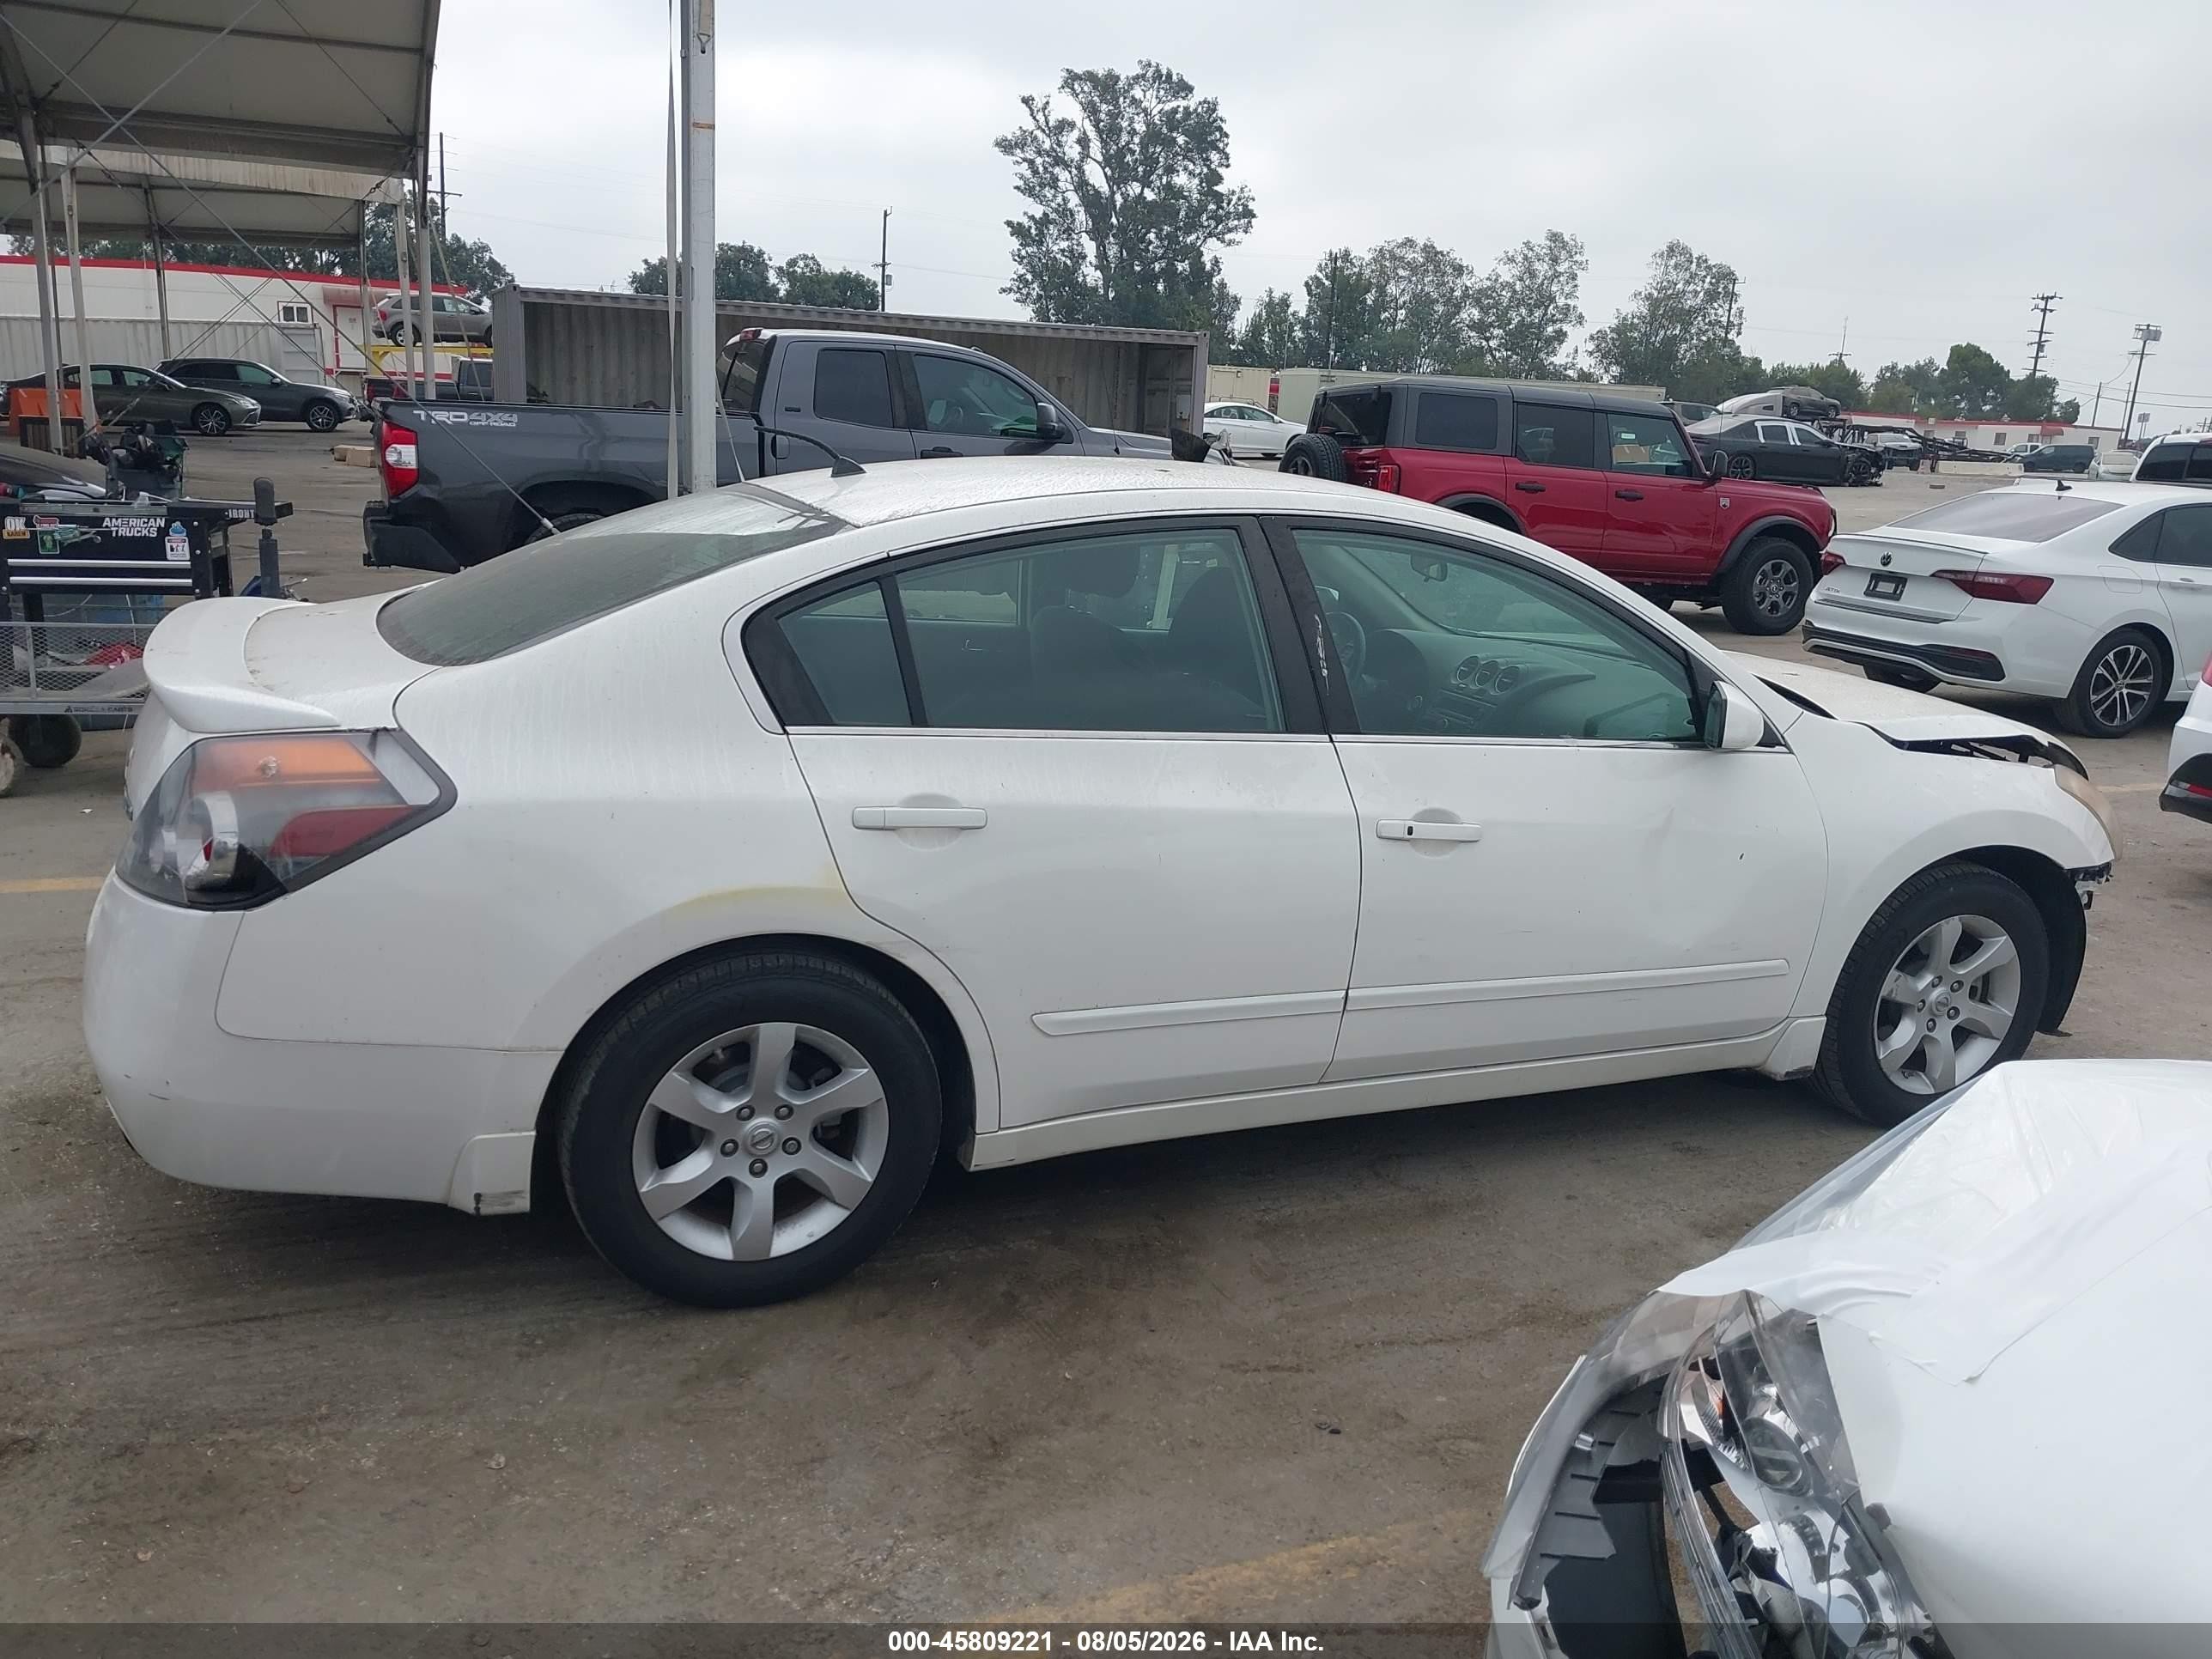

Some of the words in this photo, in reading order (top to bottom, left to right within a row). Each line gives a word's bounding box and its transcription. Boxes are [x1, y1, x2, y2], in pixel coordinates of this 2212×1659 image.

[413, 410, 468, 425] TRD
[5, 517, 26, 531] OK
[102, 517, 166, 527] AMERICAN
[111, 527, 158, 538] TRUCKS
